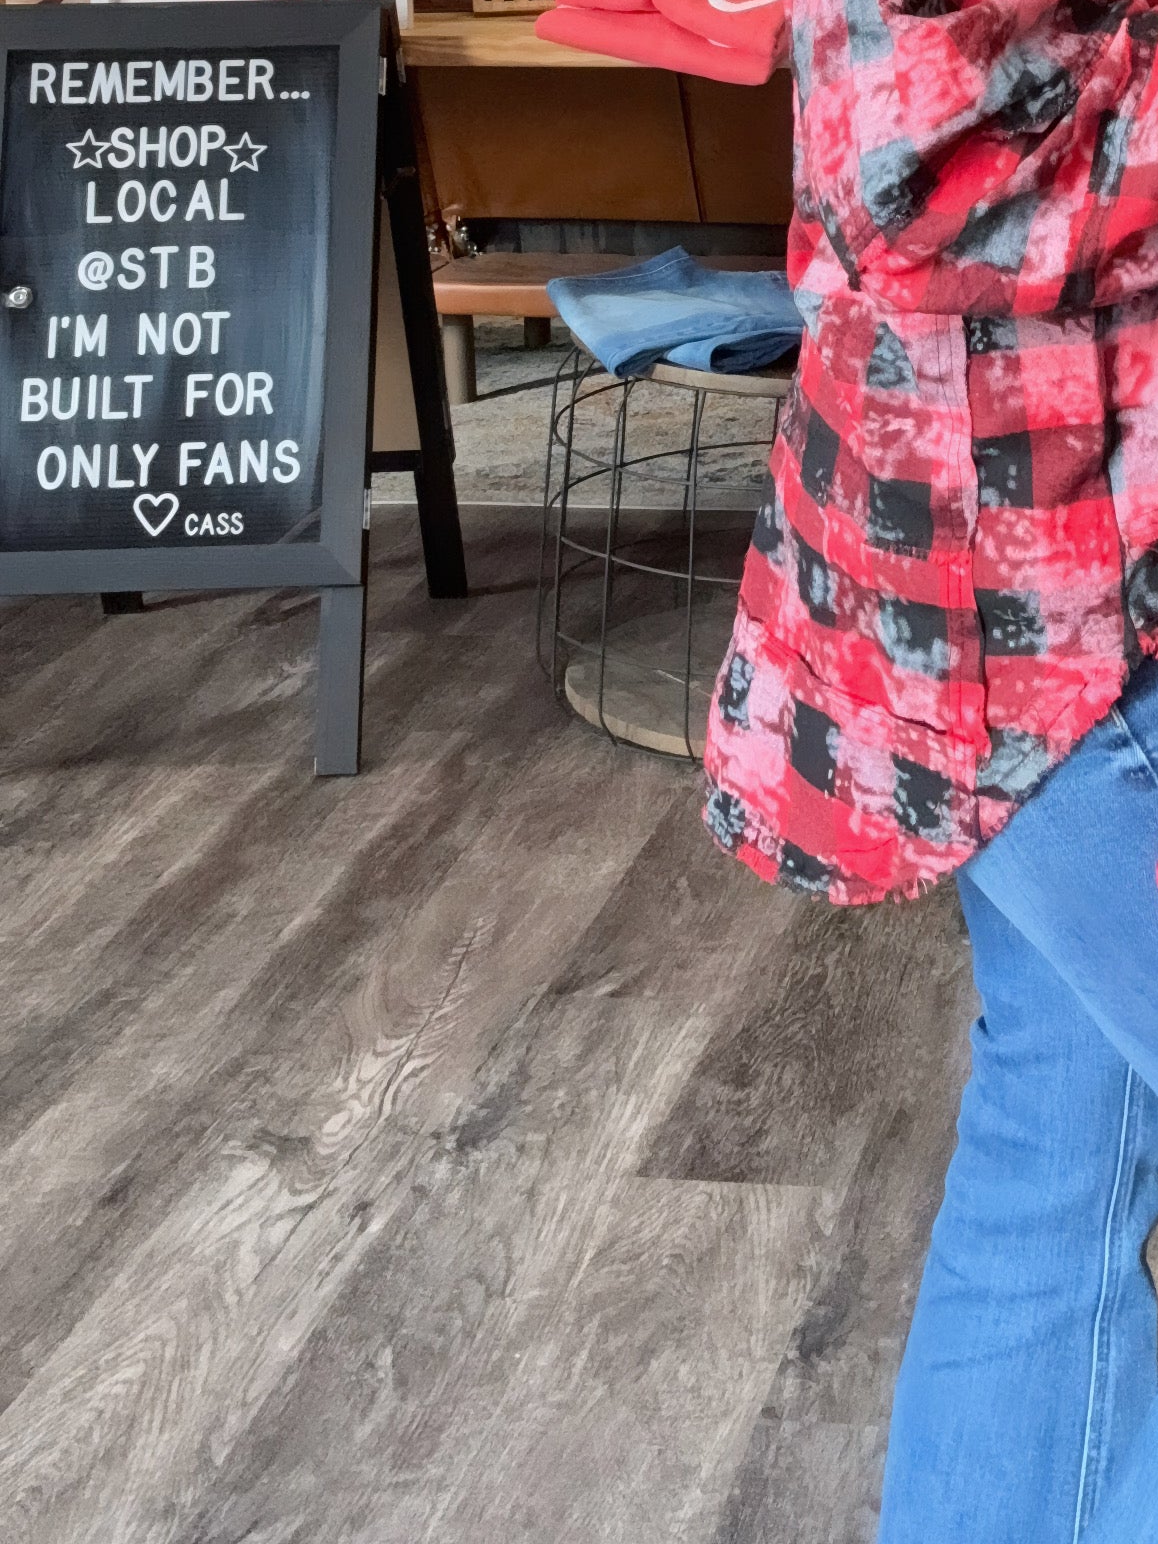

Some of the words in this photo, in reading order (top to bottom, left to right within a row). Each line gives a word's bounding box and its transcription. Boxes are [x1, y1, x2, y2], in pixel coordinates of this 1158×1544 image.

[108, 125, 227, 168] SHOP
[85, 178, 246, 224] LOCAL
[77, 245, 217, 291] @STB
[47, 314, 108, 359] I'M
[138, 311, 231, 355] NOT
[20, 374, 154, 422] BUILT
[185, 371, 274, 417] FOR
[36, 442, 160, 490] ONLY
[178, 439, 301, 486] FANS
[184, 512, 245, 536] CASS
